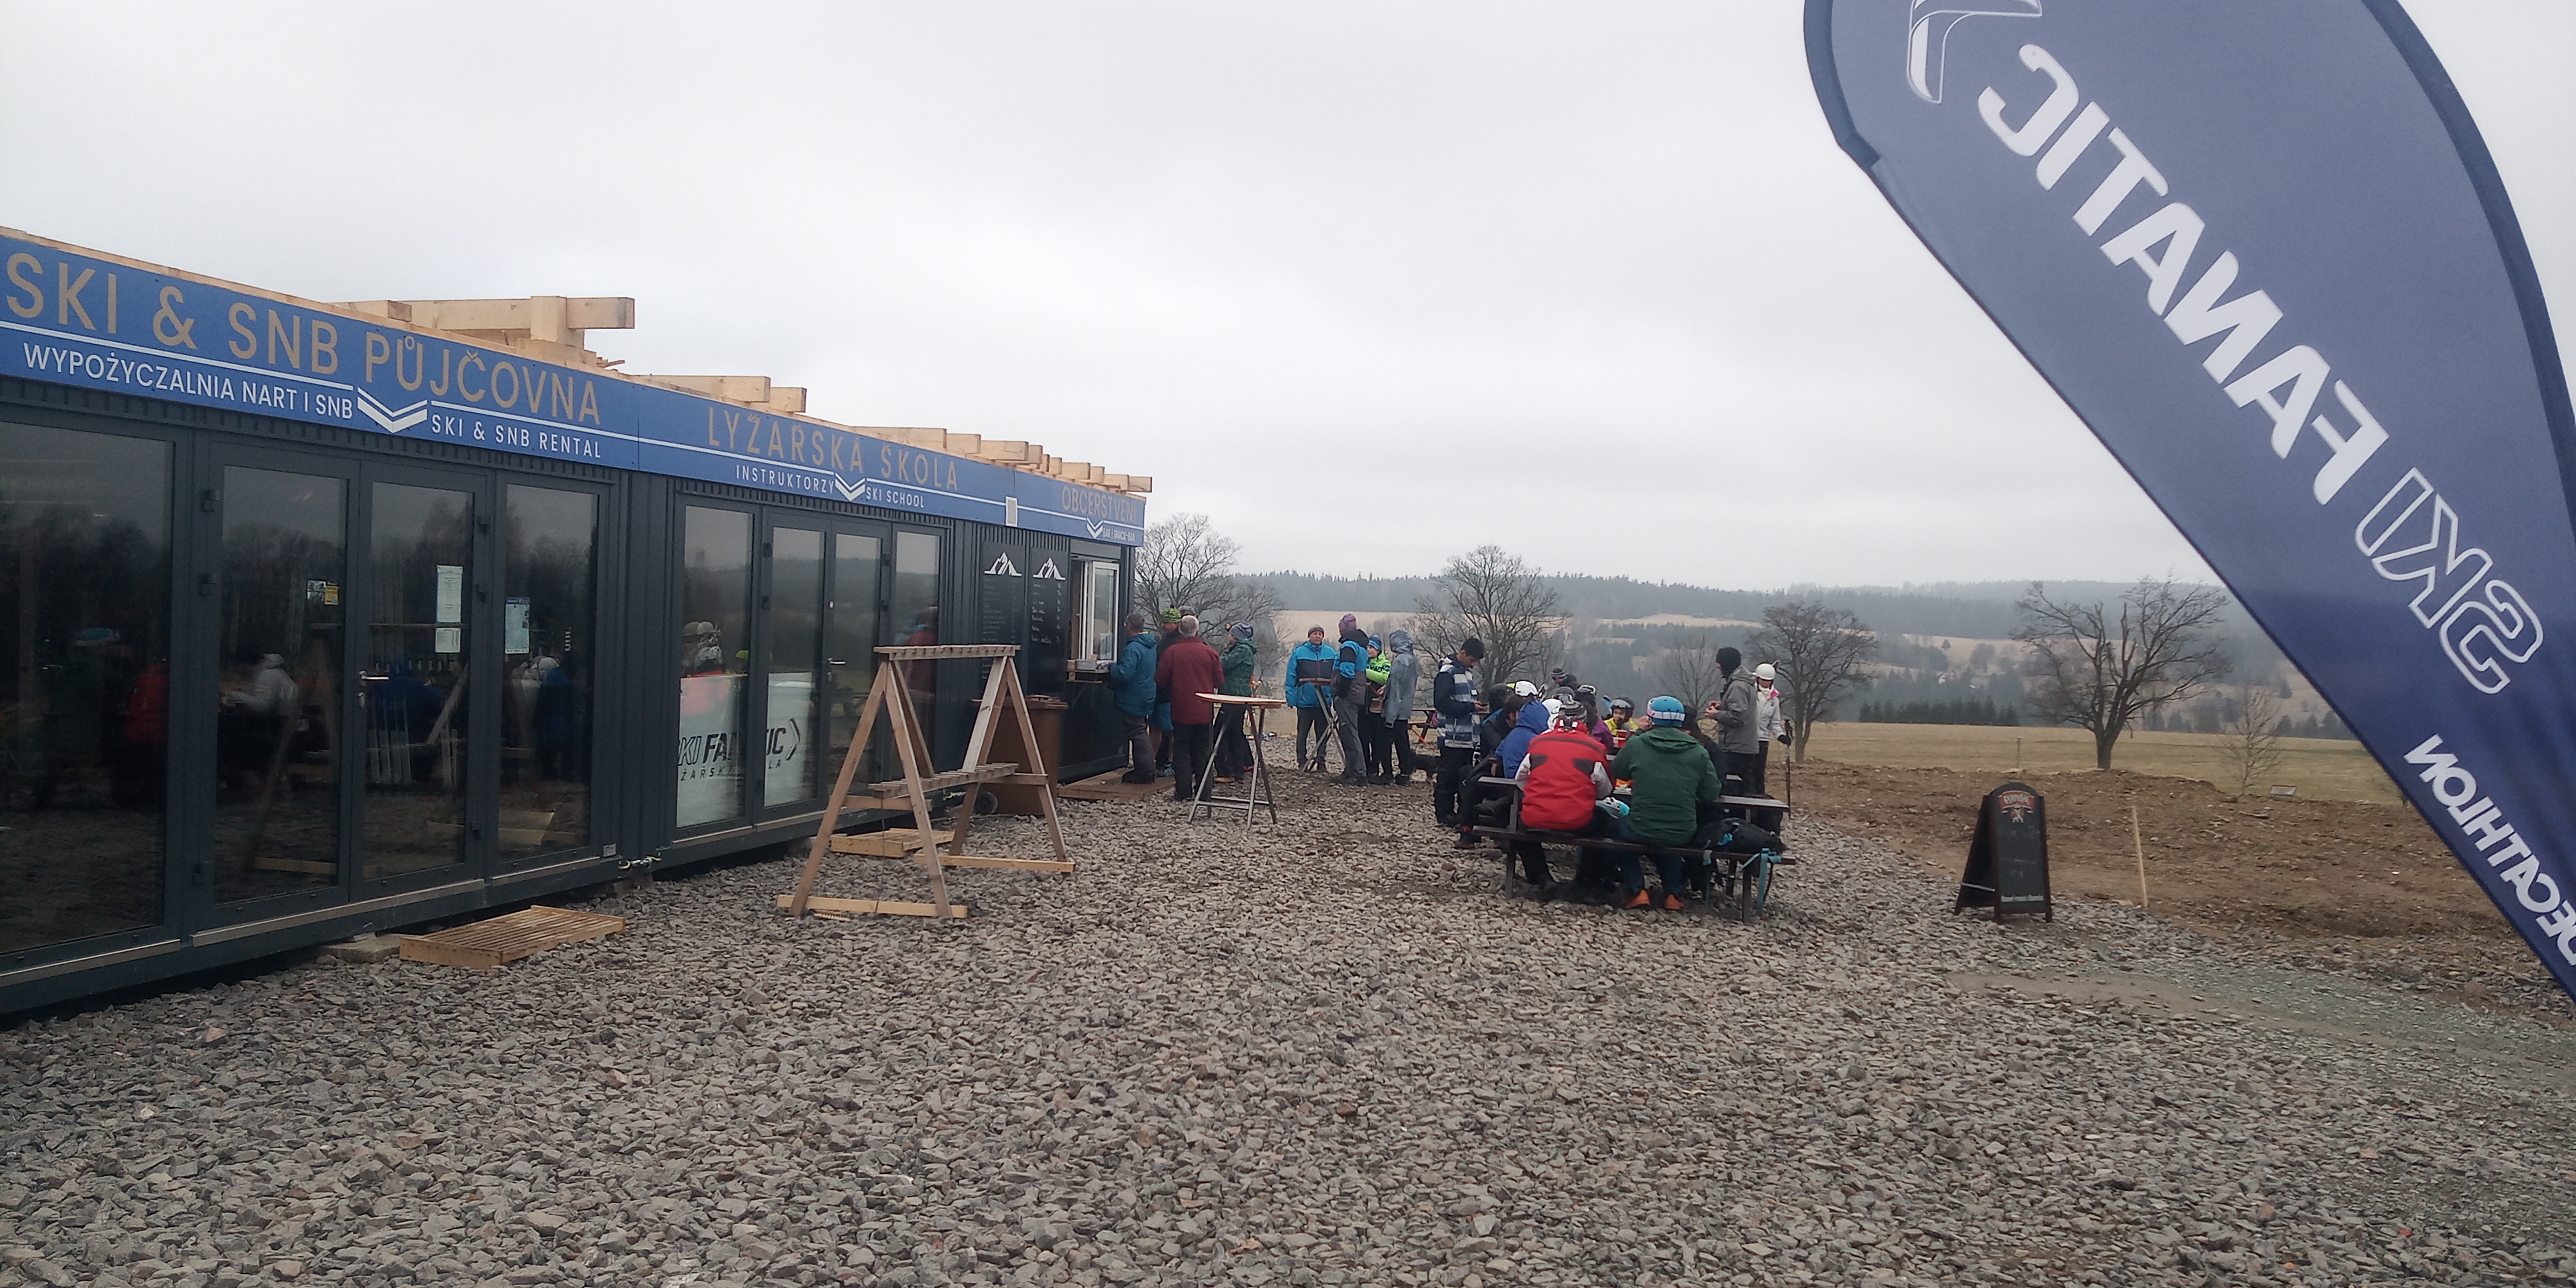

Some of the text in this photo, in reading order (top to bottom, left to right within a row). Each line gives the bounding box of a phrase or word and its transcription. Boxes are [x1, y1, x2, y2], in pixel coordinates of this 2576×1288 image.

[7, 252, 601, 425] SKI & SNB PŮJČOVNA
[23, 342, 353, 420] WYPOŻYCZALNIA NART I SNB
[432, 414, 601, 458] SKI & SNB RENTAL
[708, 407, 957, 491] LYŽAŘSKÁ ŠKOLA
[736, 464, 834, 494] INSTRUKTORZY
[866, 486, 924, 509] SKI SCHOOL
[678, 736, 702, 766] KI
